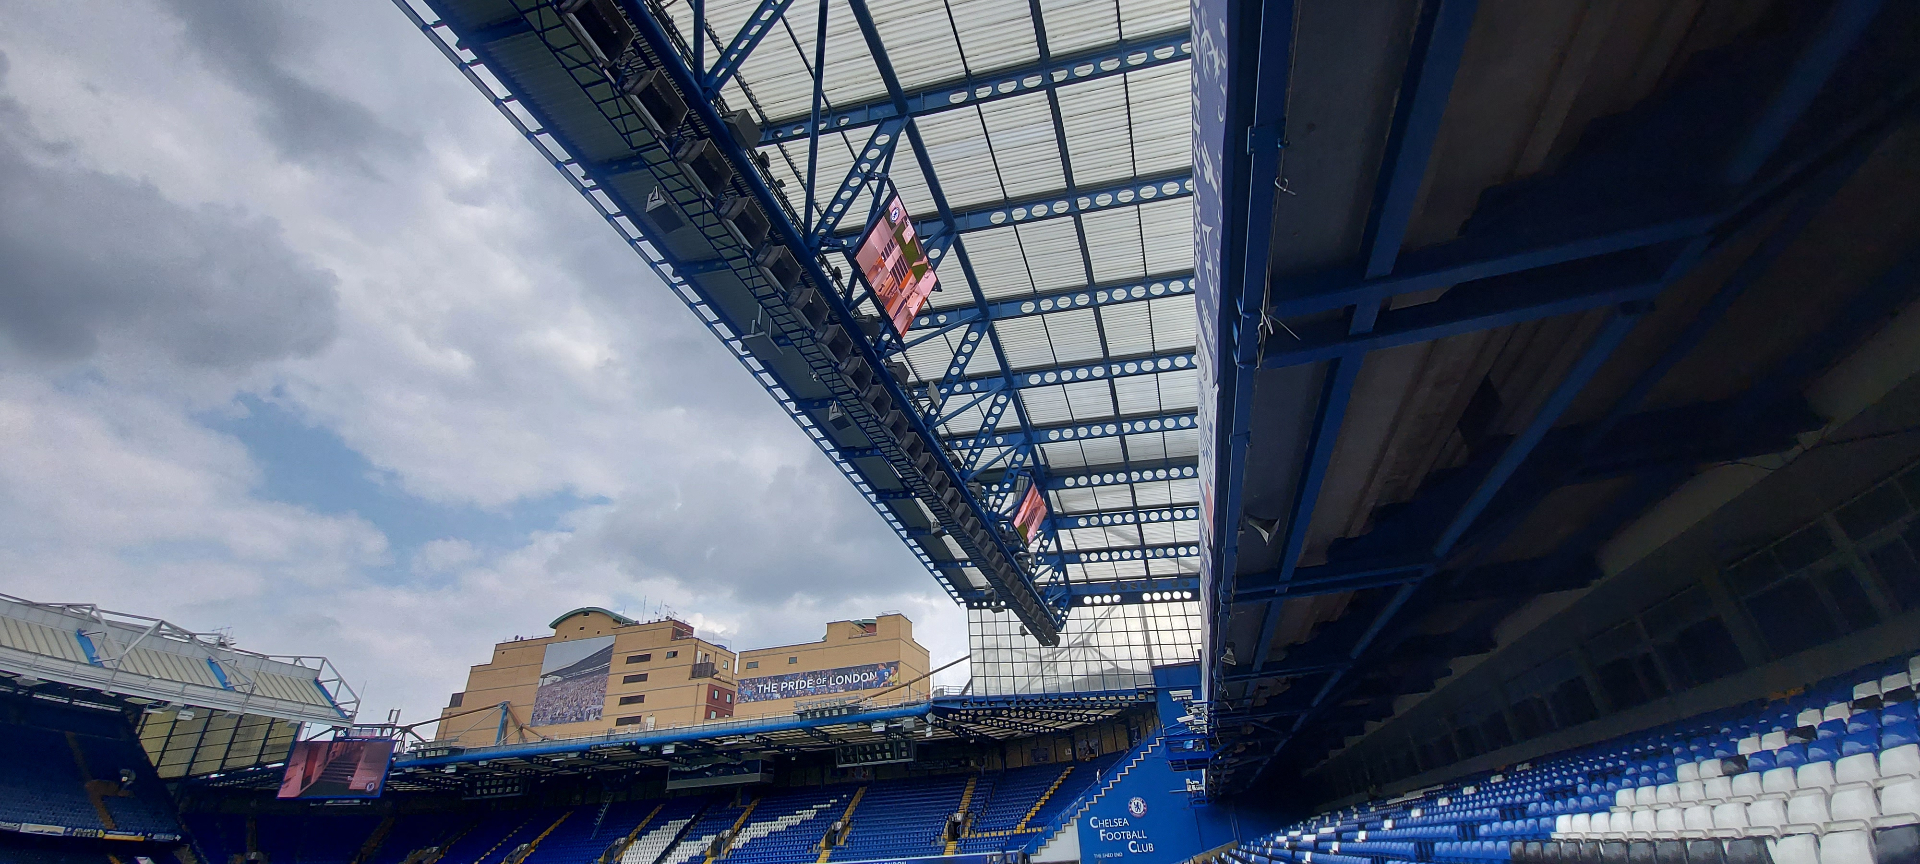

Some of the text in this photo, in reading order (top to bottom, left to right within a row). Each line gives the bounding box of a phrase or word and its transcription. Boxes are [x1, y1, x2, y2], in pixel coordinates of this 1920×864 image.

[1217, 18, 1226, 122] CLUB
[1192, 65, 1201, 178] TEXAS
[1193, 173, 1201, 283] DESERT
[757, 671, 877, 694] THE PRIDE OF LONDON
[1089, 816, 1130, 828] CHELSEA
[1100, 829, 1147, 842] FOOTBALL
[1128, 840, 1154, 853] CLUB
